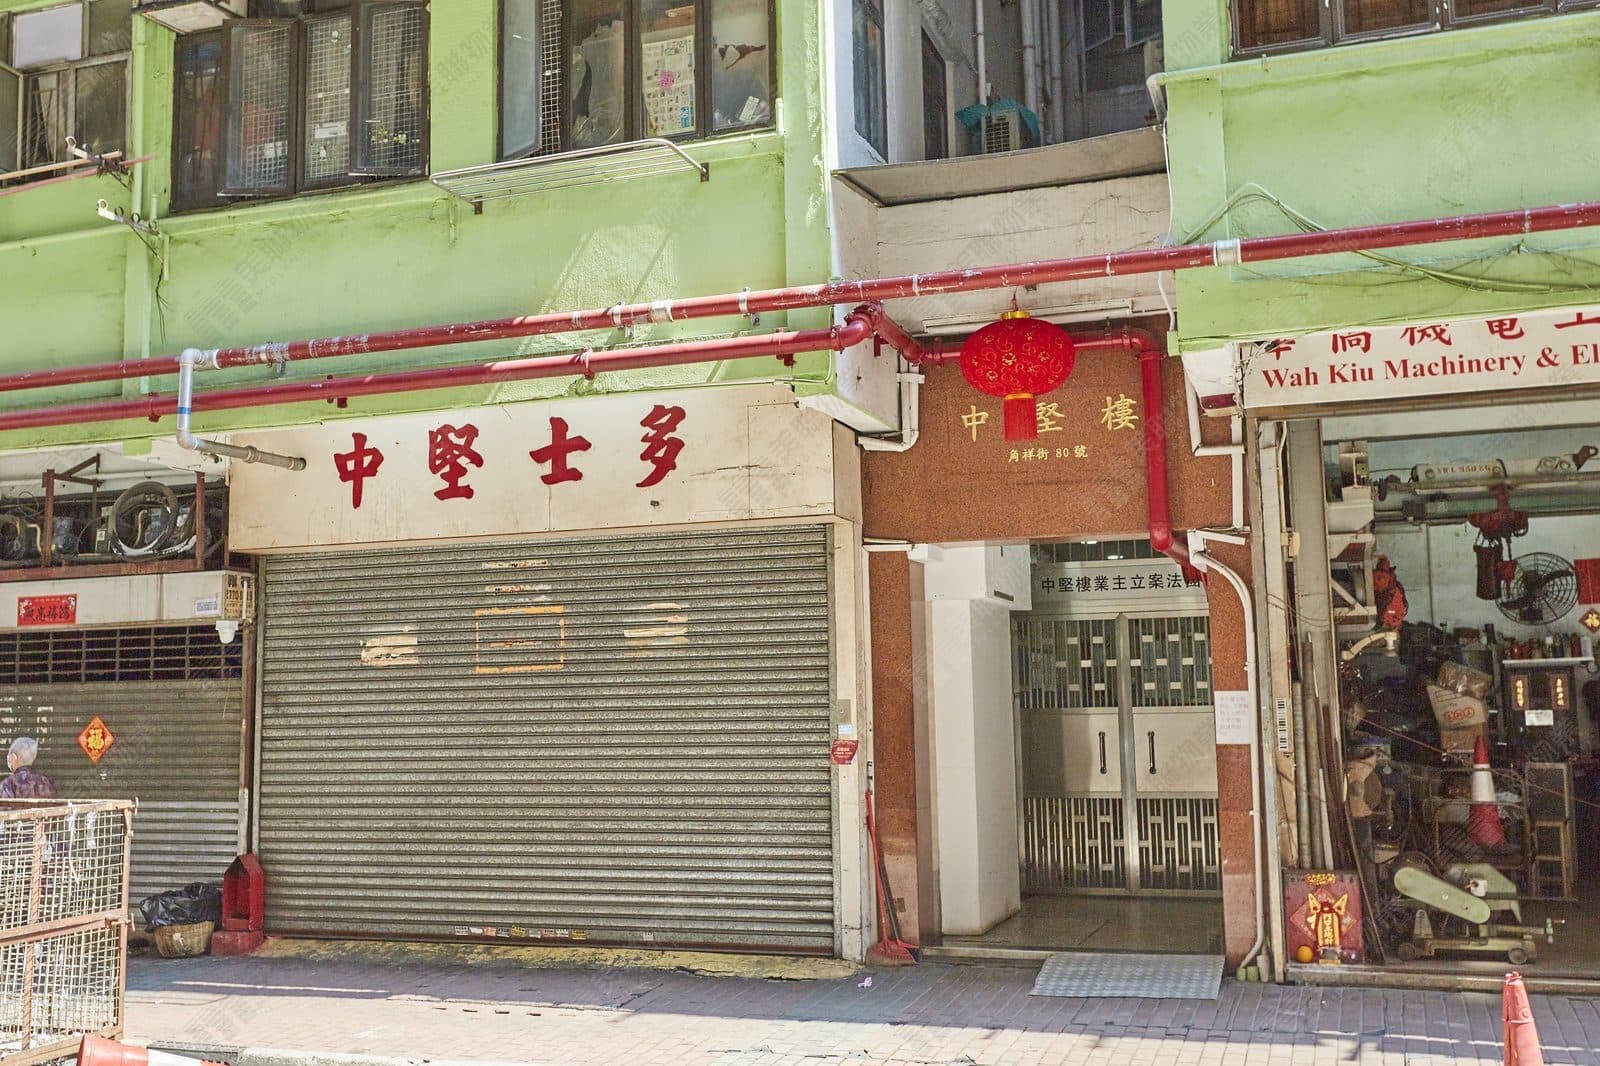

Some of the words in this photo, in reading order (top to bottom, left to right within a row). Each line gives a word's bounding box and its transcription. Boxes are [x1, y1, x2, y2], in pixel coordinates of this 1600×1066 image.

[1262, 367, 1319, 388] Wah
[1329, 363, 1374, 384] Kiu
[1384, 354, 1526, 380] Machinery
[1536, 347, 1560, 368] &
[1572, 343, 1600, 365] El
[961, 394, 1139, 442] 中堅樓
[334, 405, 686, 508] 中堅士多
[1008, 448, 1050, 463] 角祥街
[1055, 448, 1069, 459] 80
[1074, 445, 1088, 459] 號
